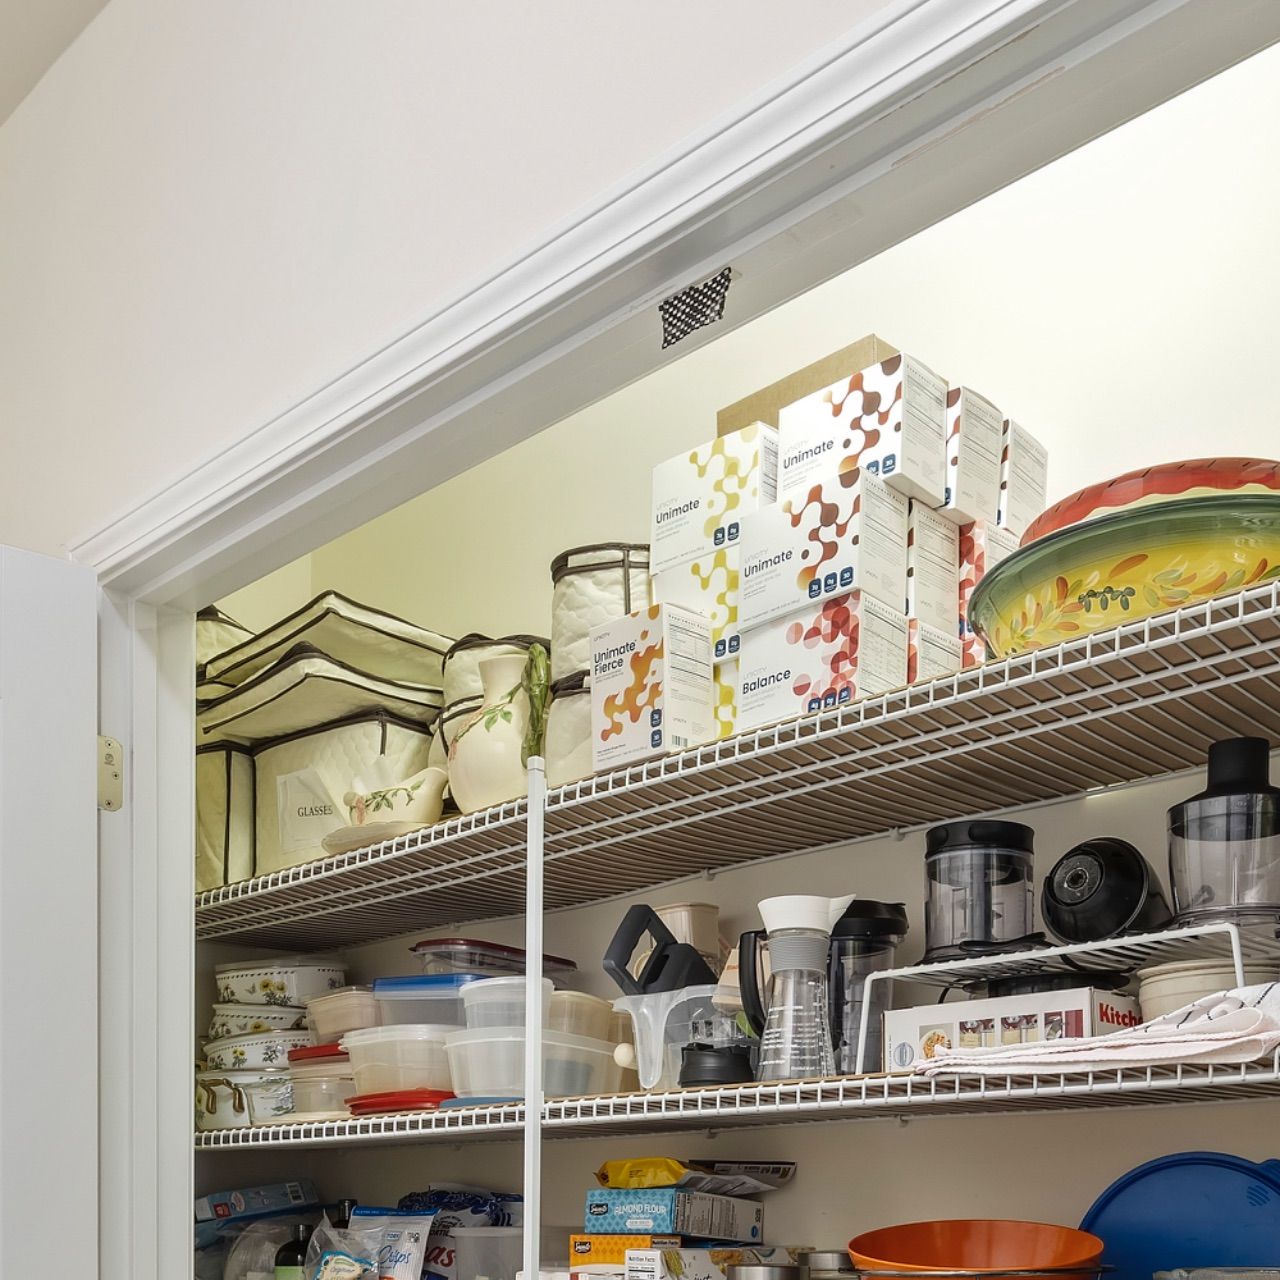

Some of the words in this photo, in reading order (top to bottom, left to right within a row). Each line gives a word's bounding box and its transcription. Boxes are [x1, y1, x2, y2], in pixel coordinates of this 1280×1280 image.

[783, 437, 834, 470] Unimate
[656, 499, 701, 525] Unimate
[744, 549, 793, 578] Unimate
[594, 640, 636, 664] Unimate
[594, 657, 624, 676] Fierce
[742, 669, 791, 695] Balance
[297, 805, 333, 817] GLASSES
